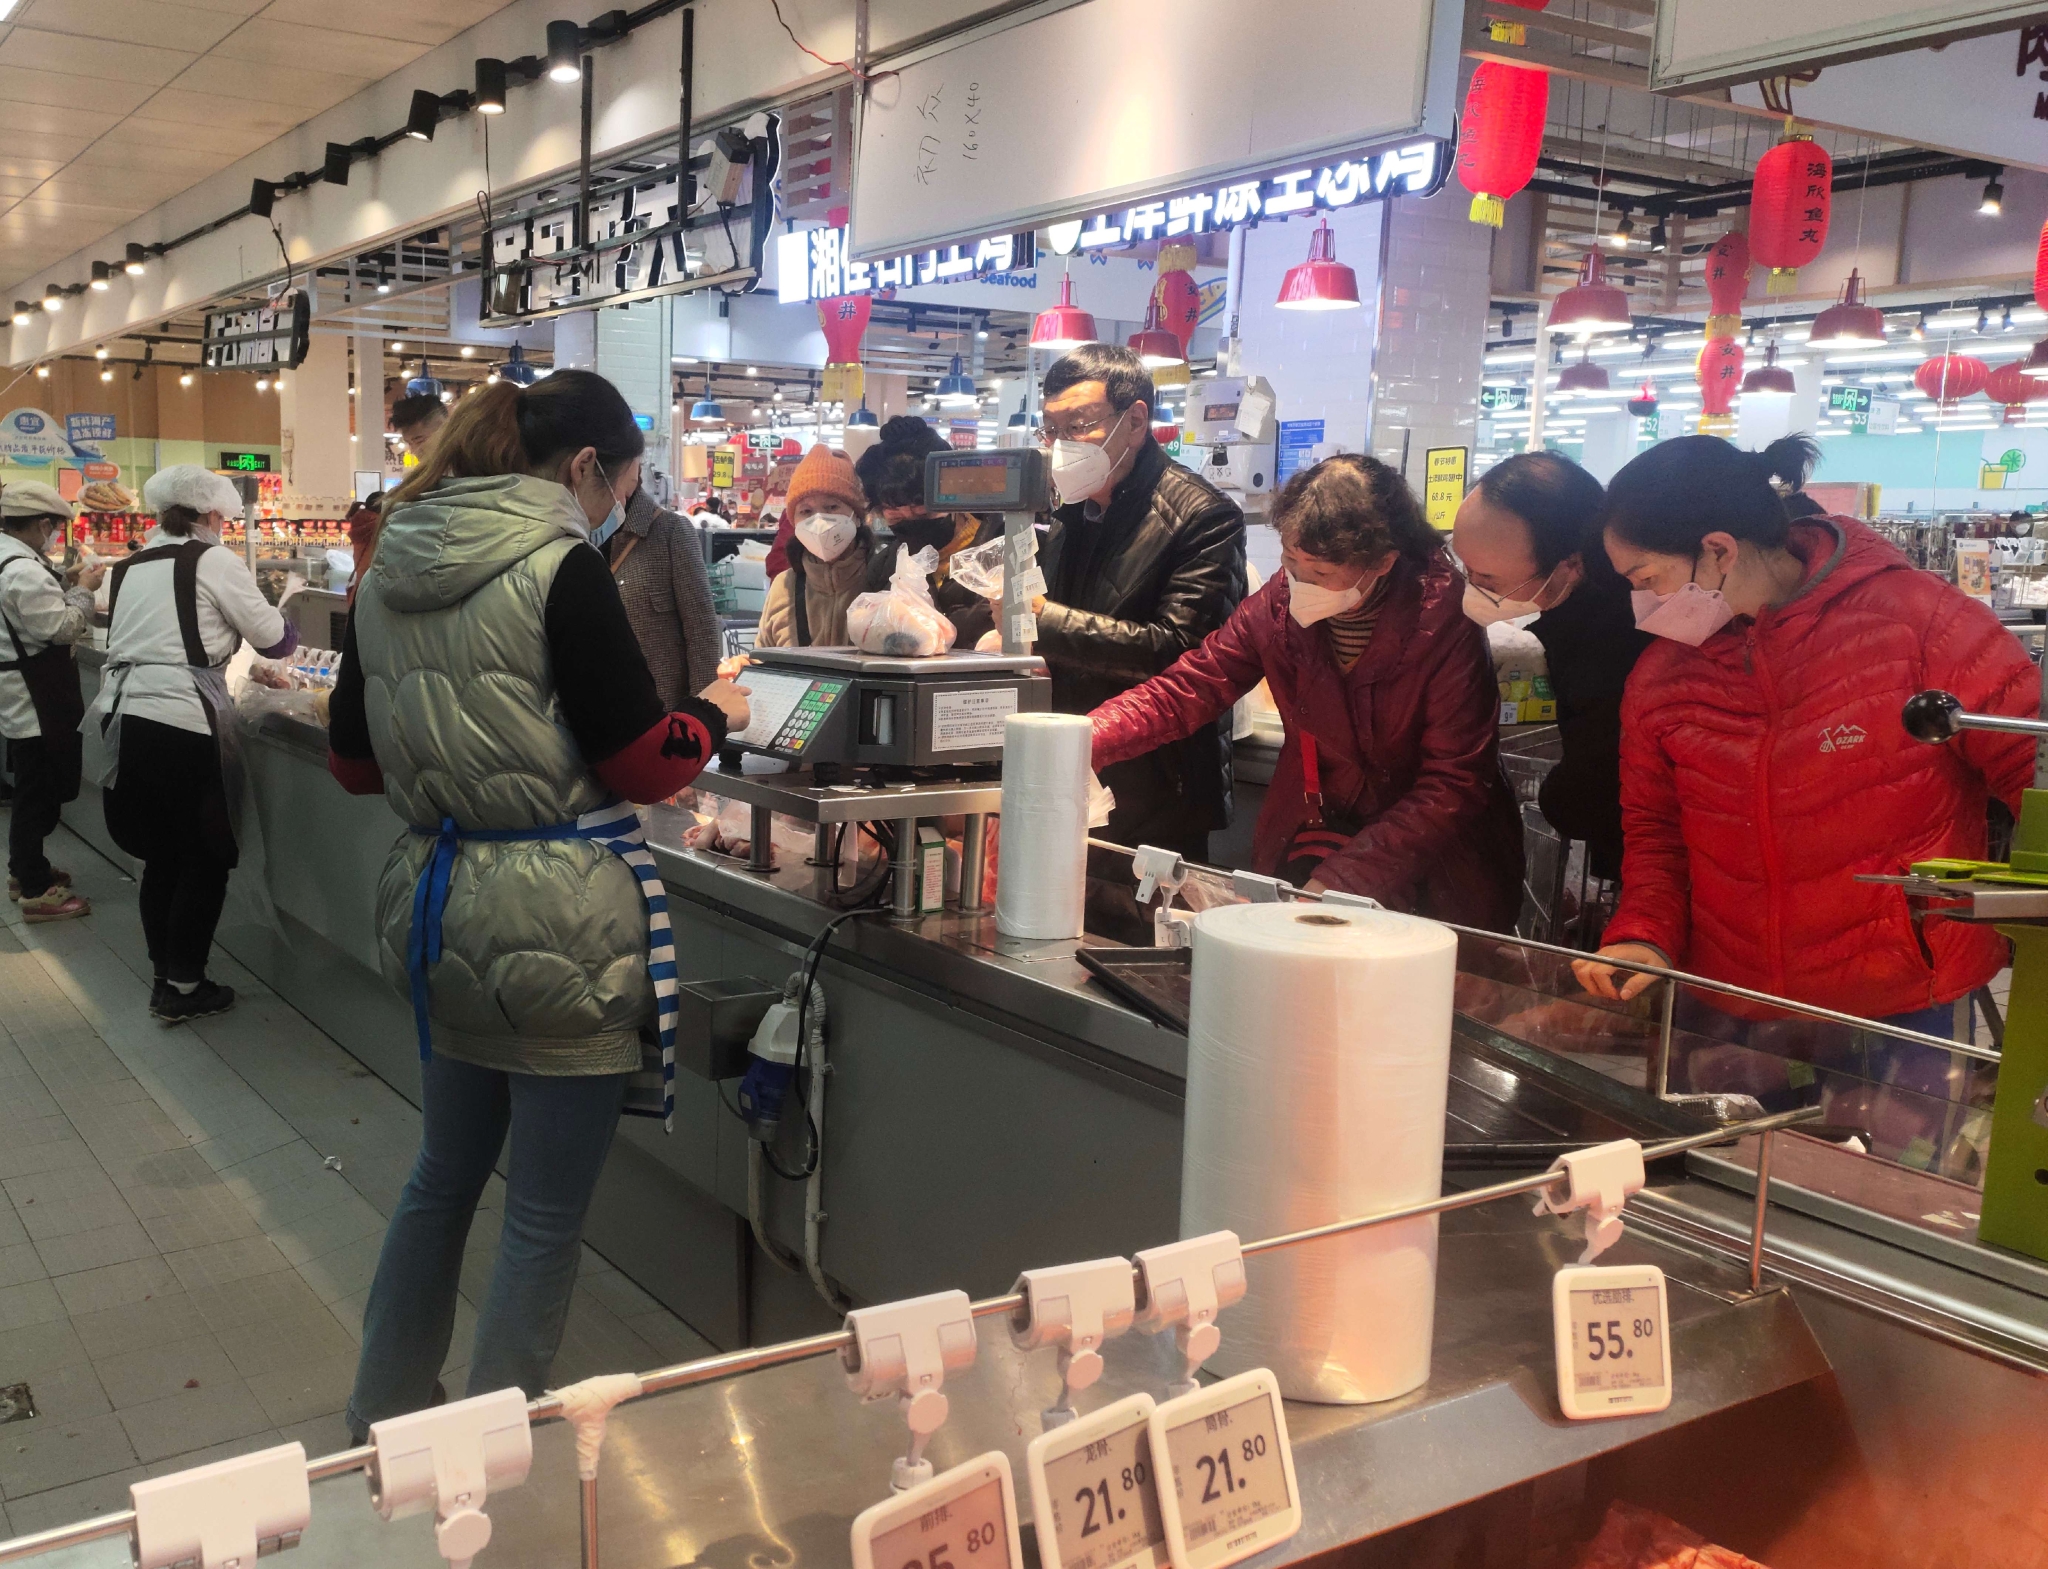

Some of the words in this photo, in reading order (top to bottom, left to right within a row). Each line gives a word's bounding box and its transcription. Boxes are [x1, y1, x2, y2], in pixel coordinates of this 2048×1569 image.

[1799, 162, 1828, 244] 海欣鱼丸
[980, 272, 1038, 289] Seafood
[1646, 416, 1658, 432] 52
[1854, 412, 1867, 425] 53
[1167, 441, 1180, 452] 49
[254, 460, 266, 469] EXIT
[1836, 735, 1866, 745] OZARK
